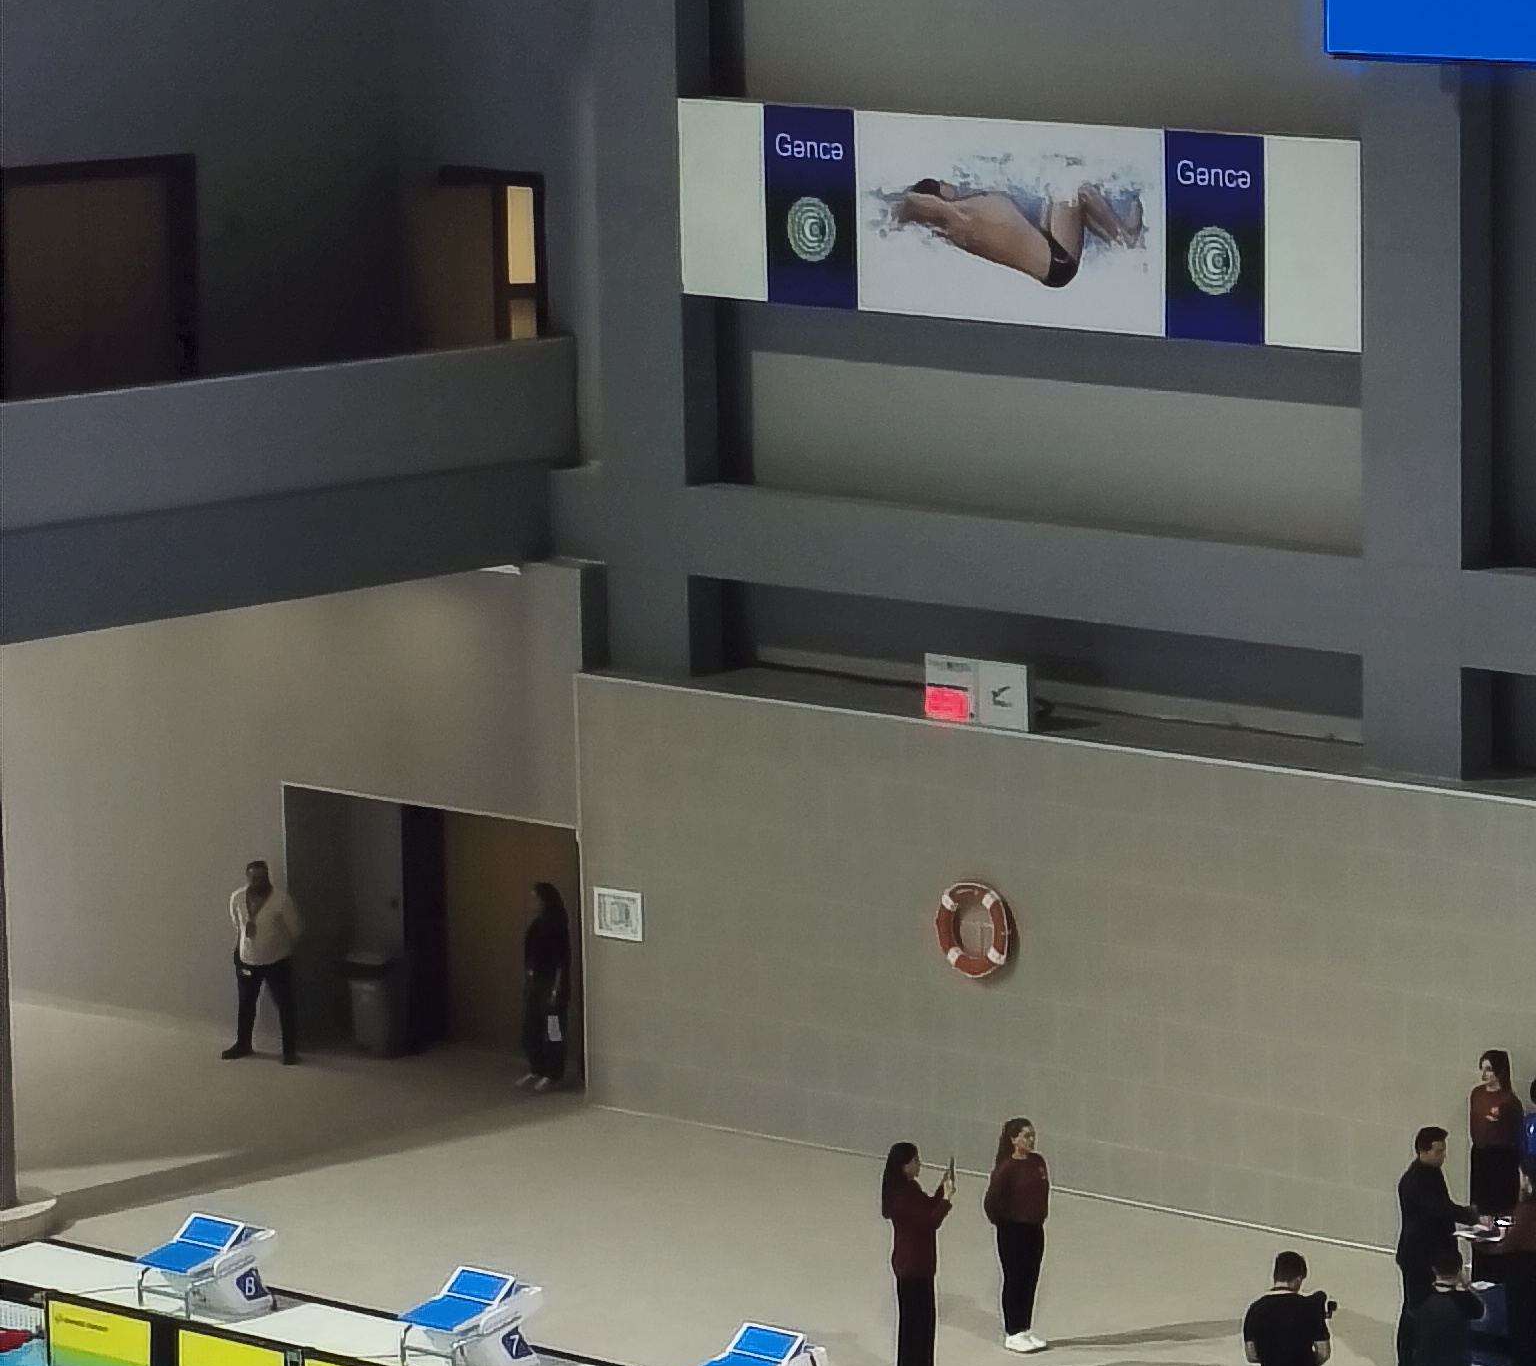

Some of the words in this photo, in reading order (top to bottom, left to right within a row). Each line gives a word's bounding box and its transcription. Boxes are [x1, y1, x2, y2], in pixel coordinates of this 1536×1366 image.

[775, 132, 844, 161] Gəncə
[1176, 159, 1251, 189] Gəncə
[510, 1334, 520, 1357] 7
